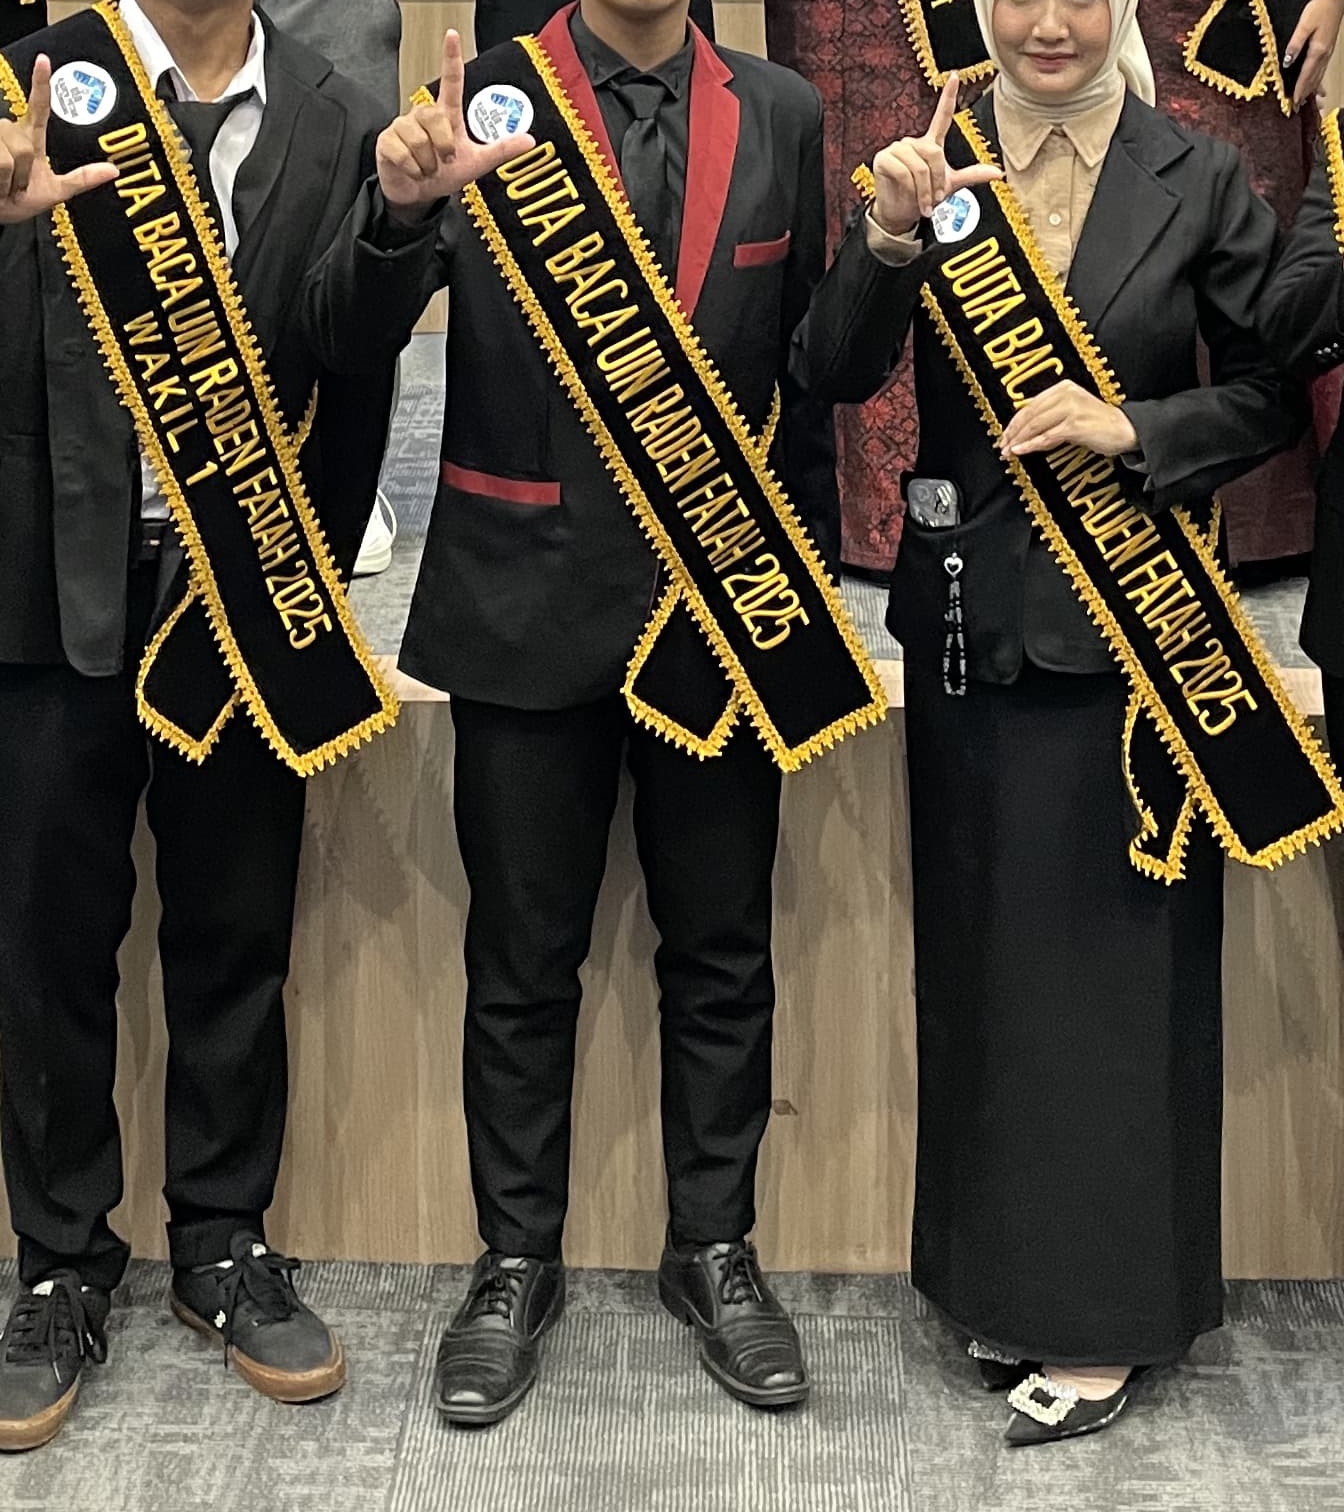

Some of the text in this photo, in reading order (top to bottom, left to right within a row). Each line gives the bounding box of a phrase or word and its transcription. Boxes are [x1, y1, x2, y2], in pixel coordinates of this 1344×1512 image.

[940, 235, 1027, 337] DUTA
[98, 122, 333, 652] DUTA BACA UIN RADEN FATAH 2025
[122, 310, 219, 486] WAKIL 1
[494, 139, 811, 651] DUTA BACA UIN RADEN FATAH 2025
[982, 316, 1064, 409] BAC
[1125, 549, 1209, 671] FATAH
[1168, 637, 1259, 738] 2025
